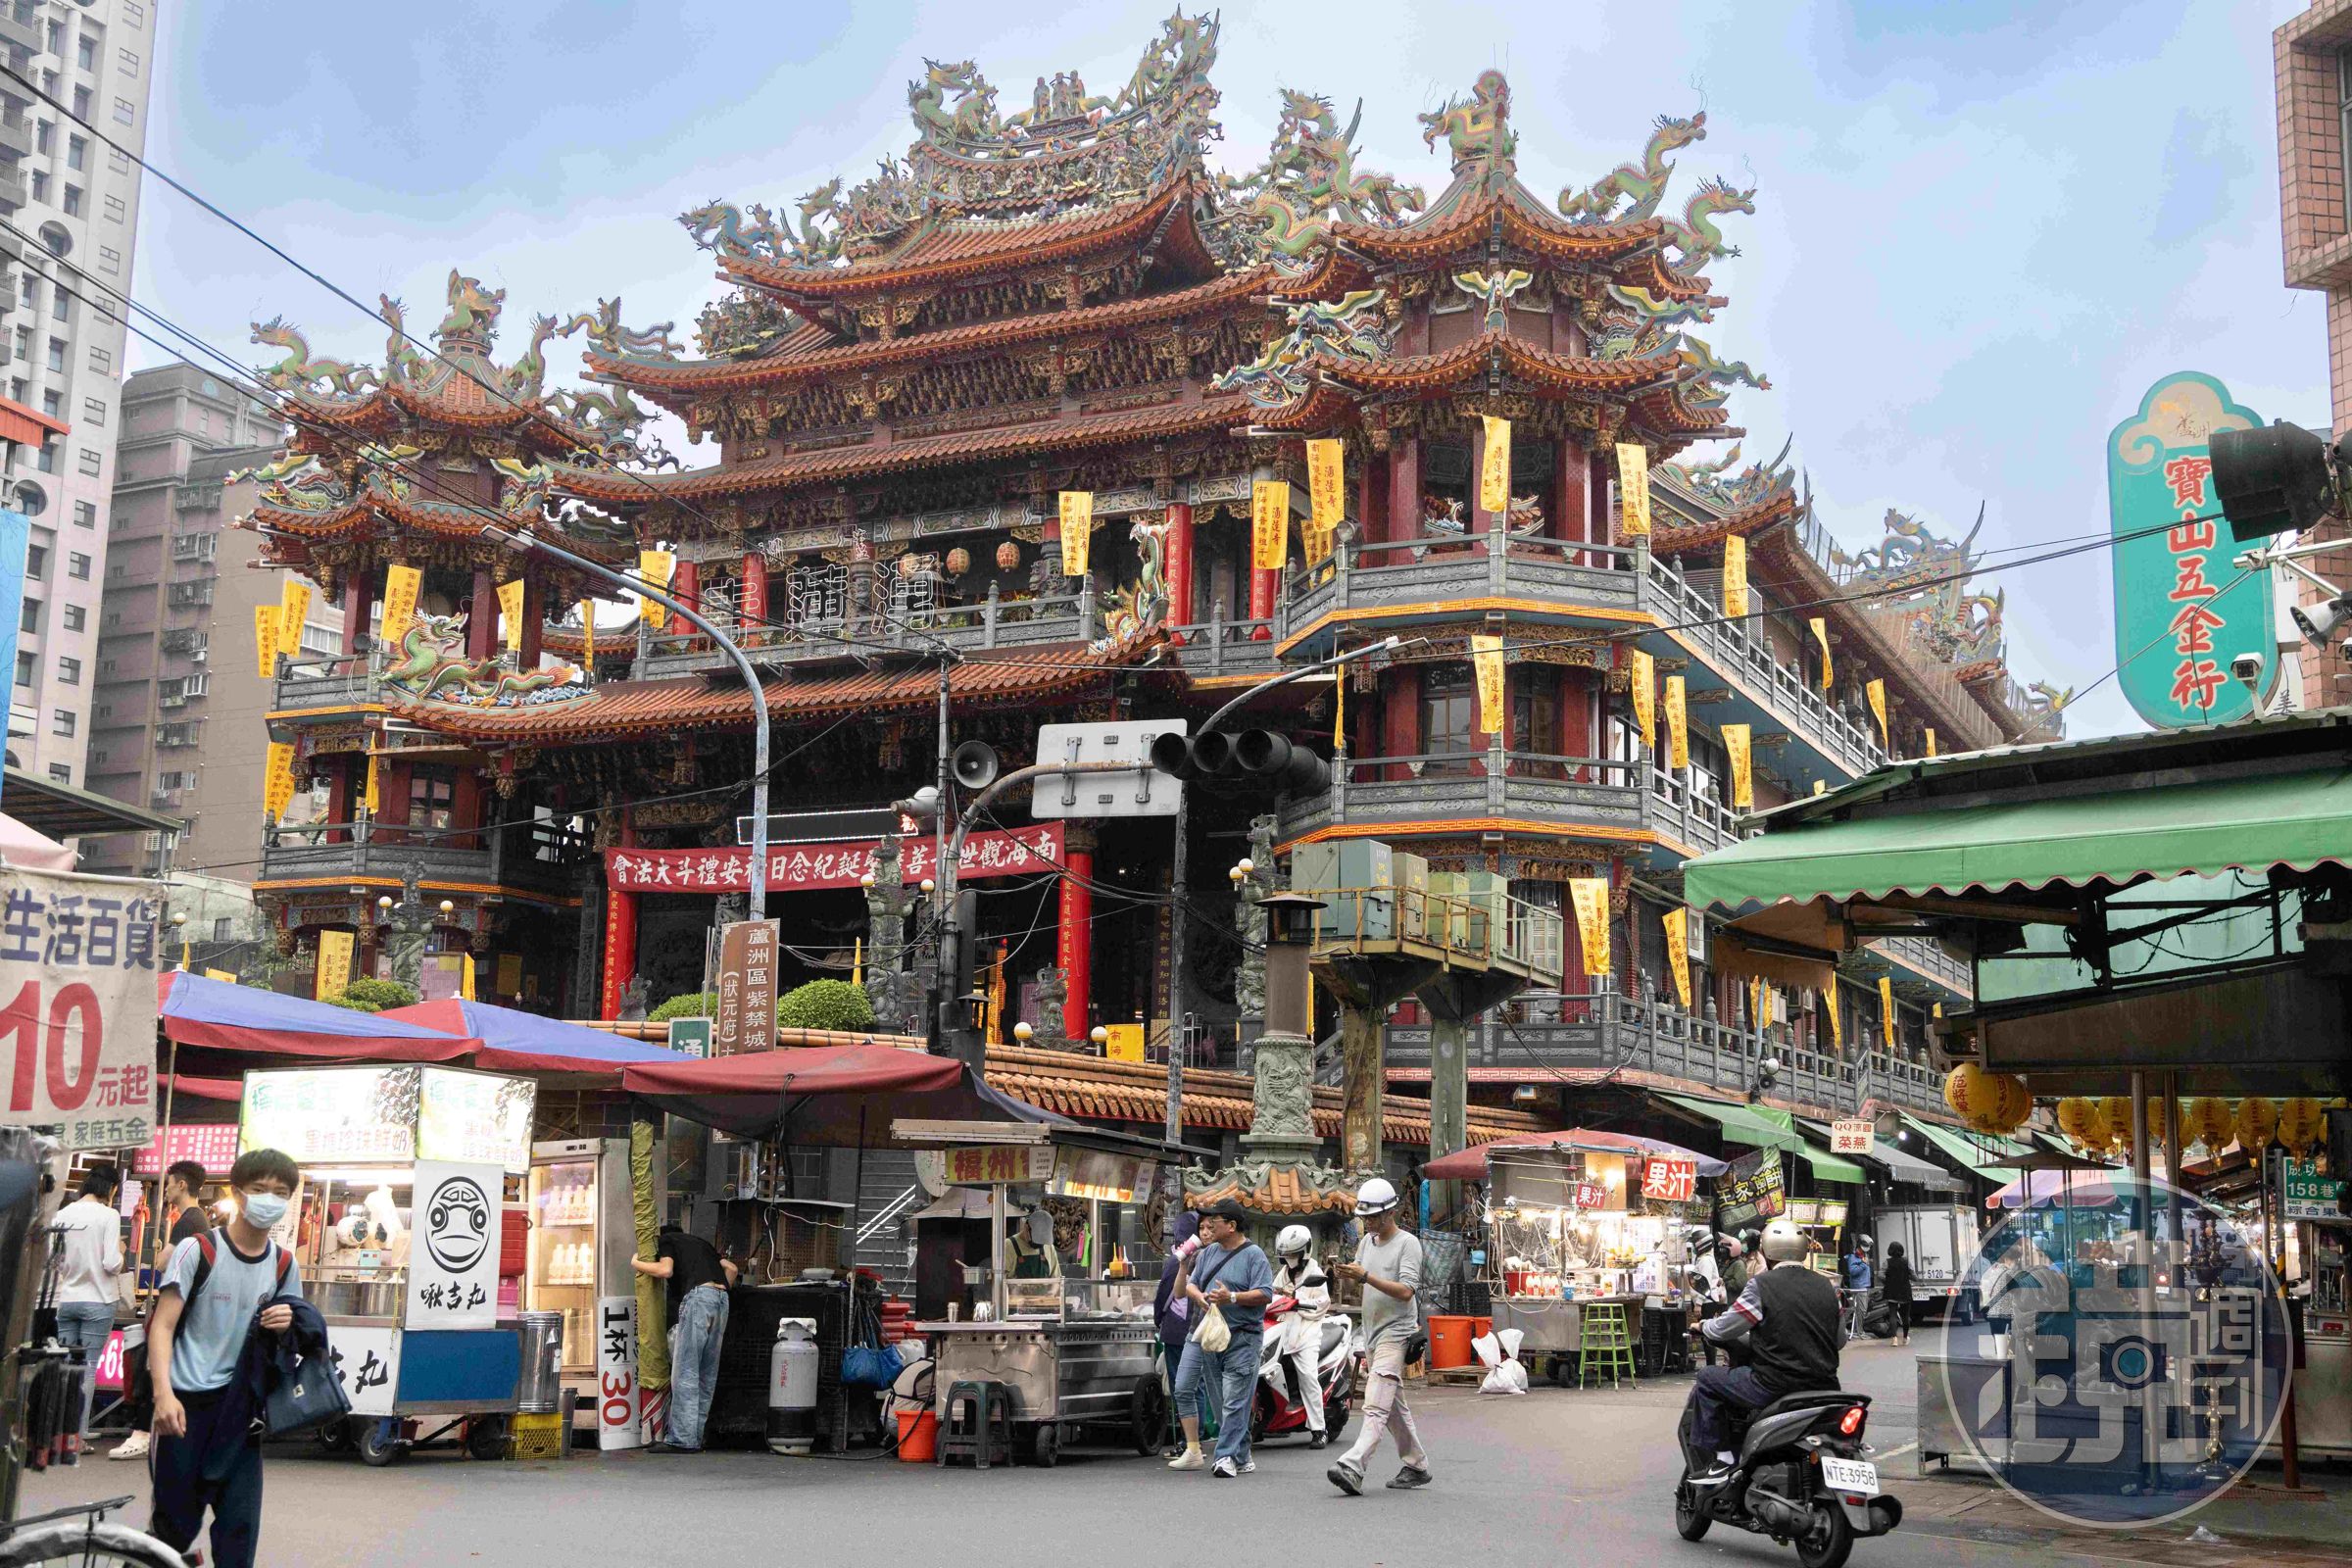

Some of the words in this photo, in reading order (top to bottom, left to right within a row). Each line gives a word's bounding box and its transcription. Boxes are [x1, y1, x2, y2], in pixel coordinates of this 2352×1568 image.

[2164, 456, 2228, 712] 寶山五金行
[1, 887, 158, 970] 生活百貨
[744, 928, 770, 1048] 蘆洲區紫禁城
[1579, 1186, 1604, 1205] 果汁
[1644, 1161, 1691, 1198] 果汁
[2287, 1182, 2334, 1198] 158巷
[2286, 1204, 2346, 1217] 綜合果
[1927, 1269, 1944, 1279] 5120
[604, 1306, 630, 1363] 1杯
[602, 1370, 632, 1426] 30
[1825, 1465, 1876, 1487] NTE-3958
